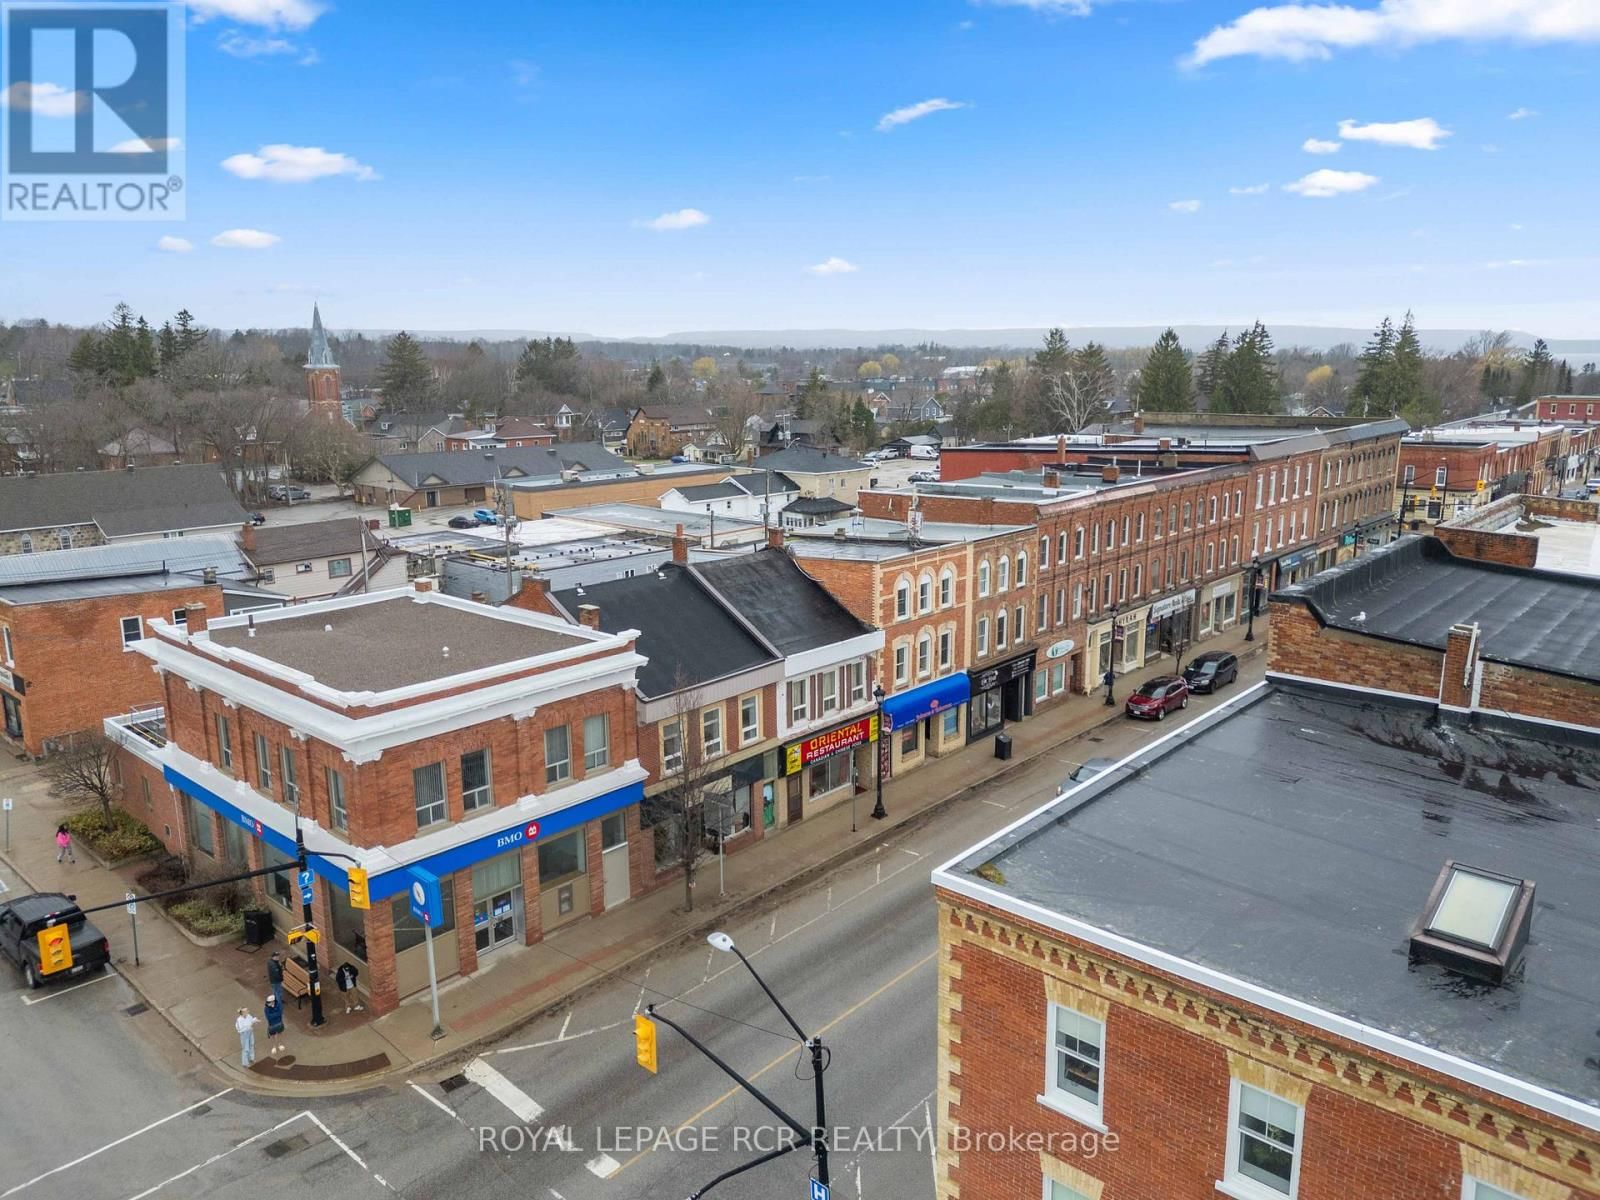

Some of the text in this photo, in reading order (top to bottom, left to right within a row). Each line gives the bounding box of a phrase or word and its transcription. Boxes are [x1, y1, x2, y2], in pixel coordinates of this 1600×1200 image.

[806, 732, 865, 760] RESTAURANT
[810, 723, 862, 750] ORIENTAL
[496, 831, 522, 848] BMO
[814, 1183, 826, 1200] H
